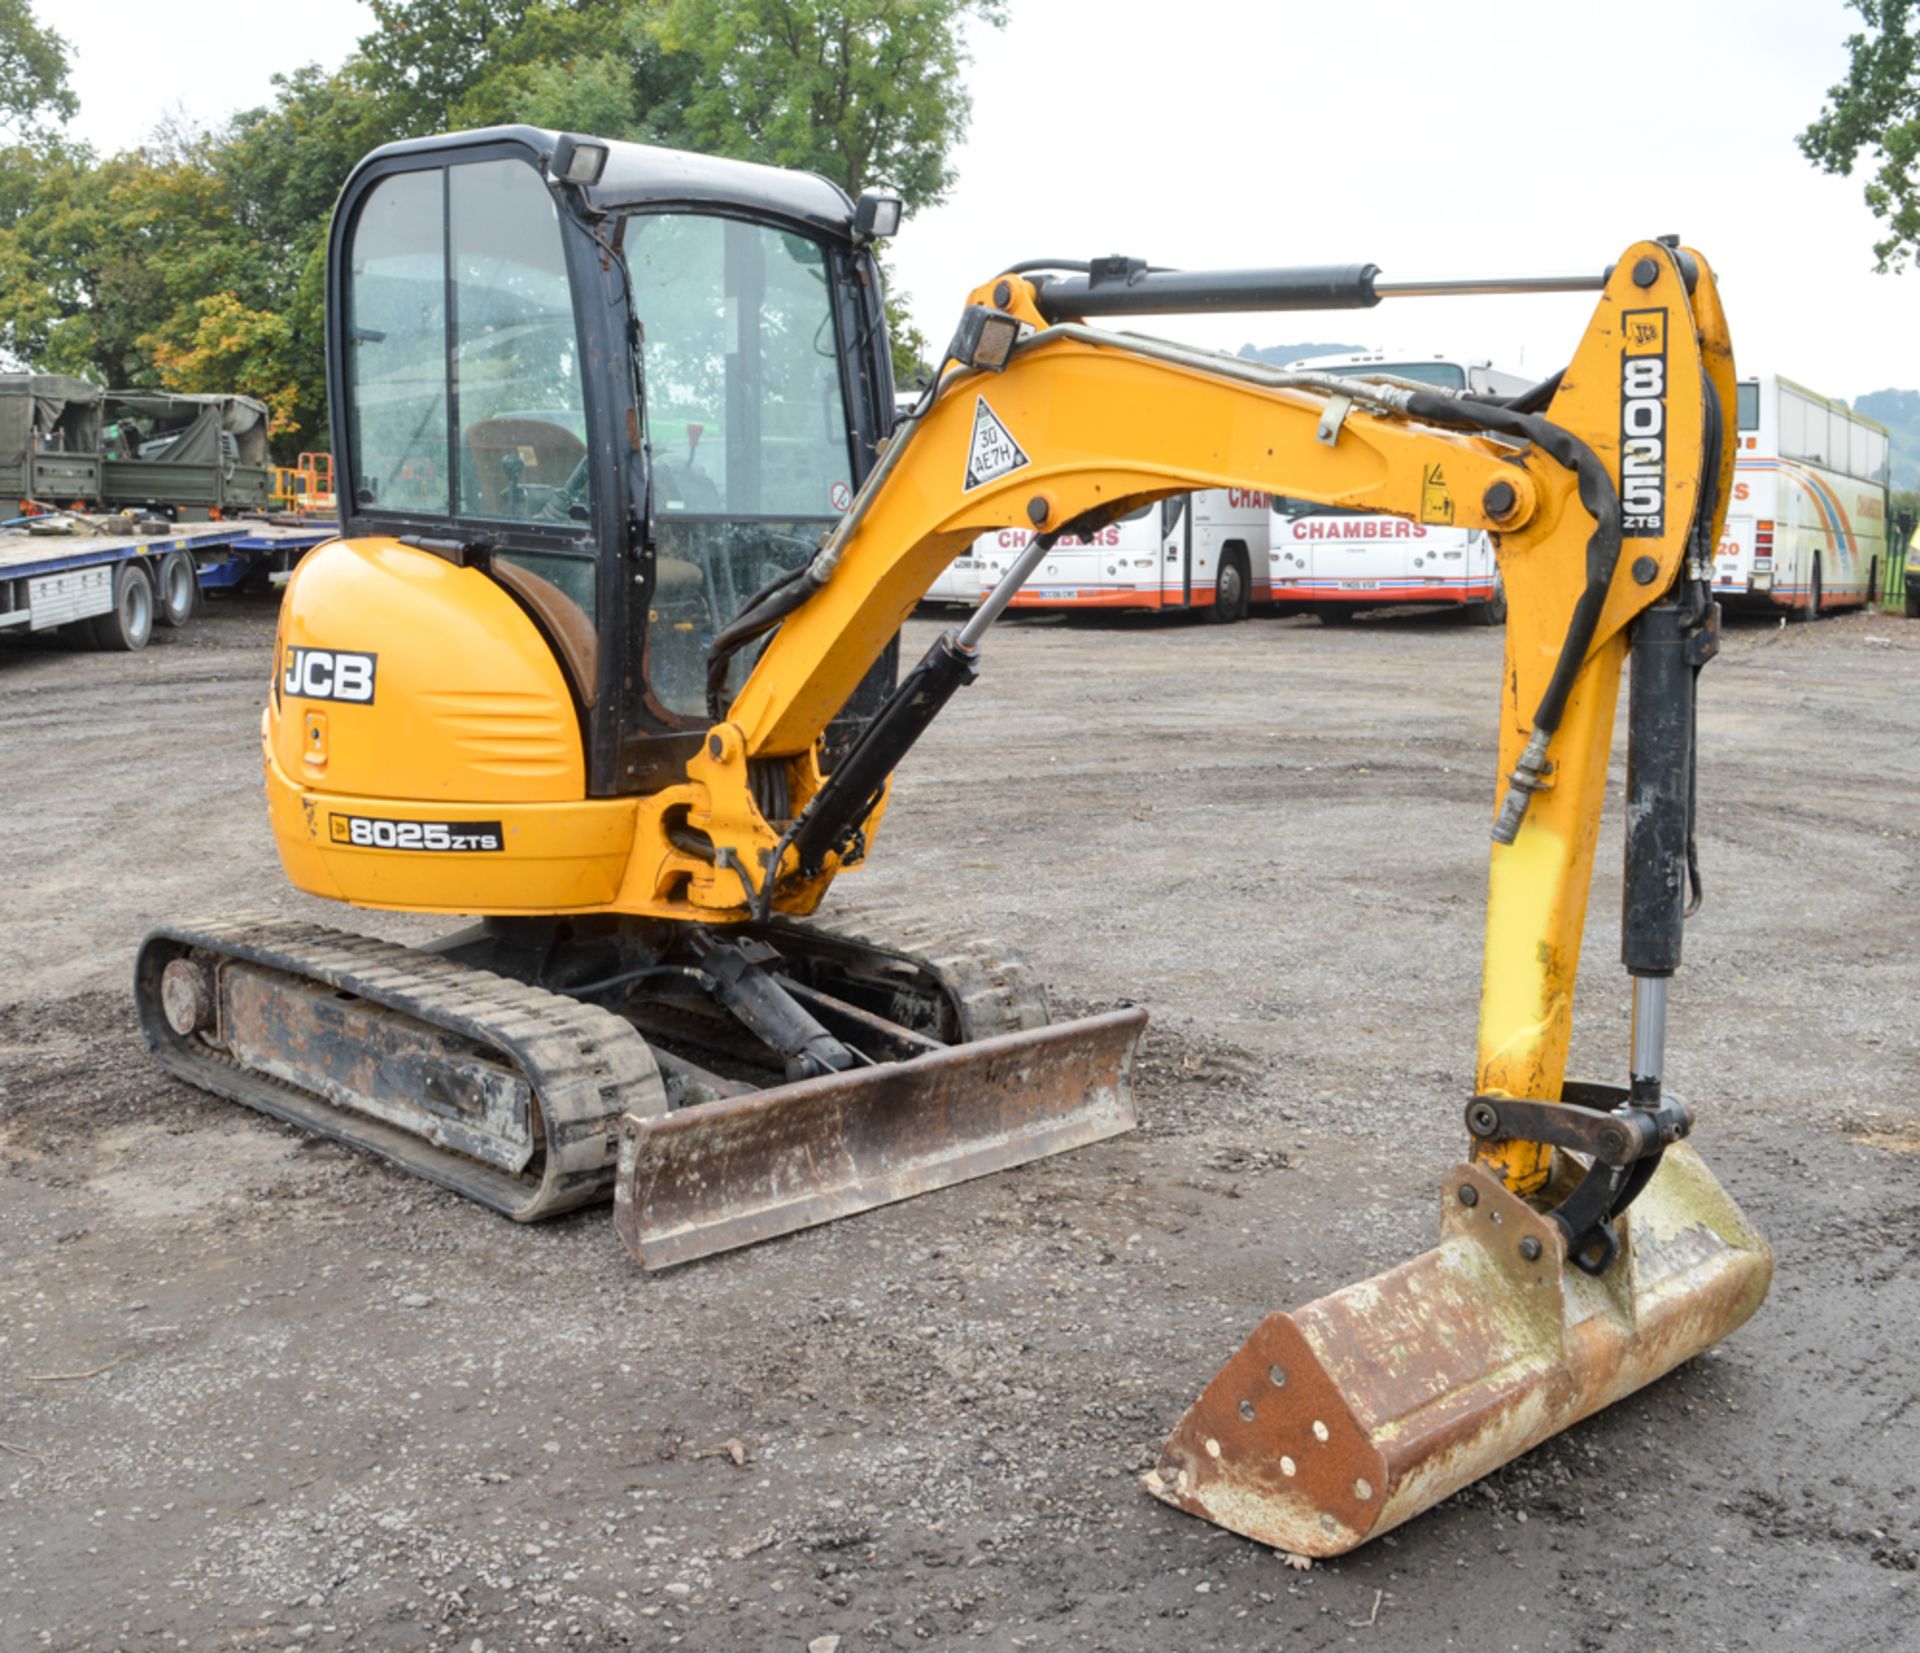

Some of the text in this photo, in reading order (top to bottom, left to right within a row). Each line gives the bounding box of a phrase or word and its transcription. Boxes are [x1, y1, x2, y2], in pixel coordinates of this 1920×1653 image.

[1623, 358, 1663, 514] 8025
[1293, 521, 1427, 539] CHAMBERS
[1622, 516, 1661, 528] ZTS
[286, 651, 373, 700] JCB
